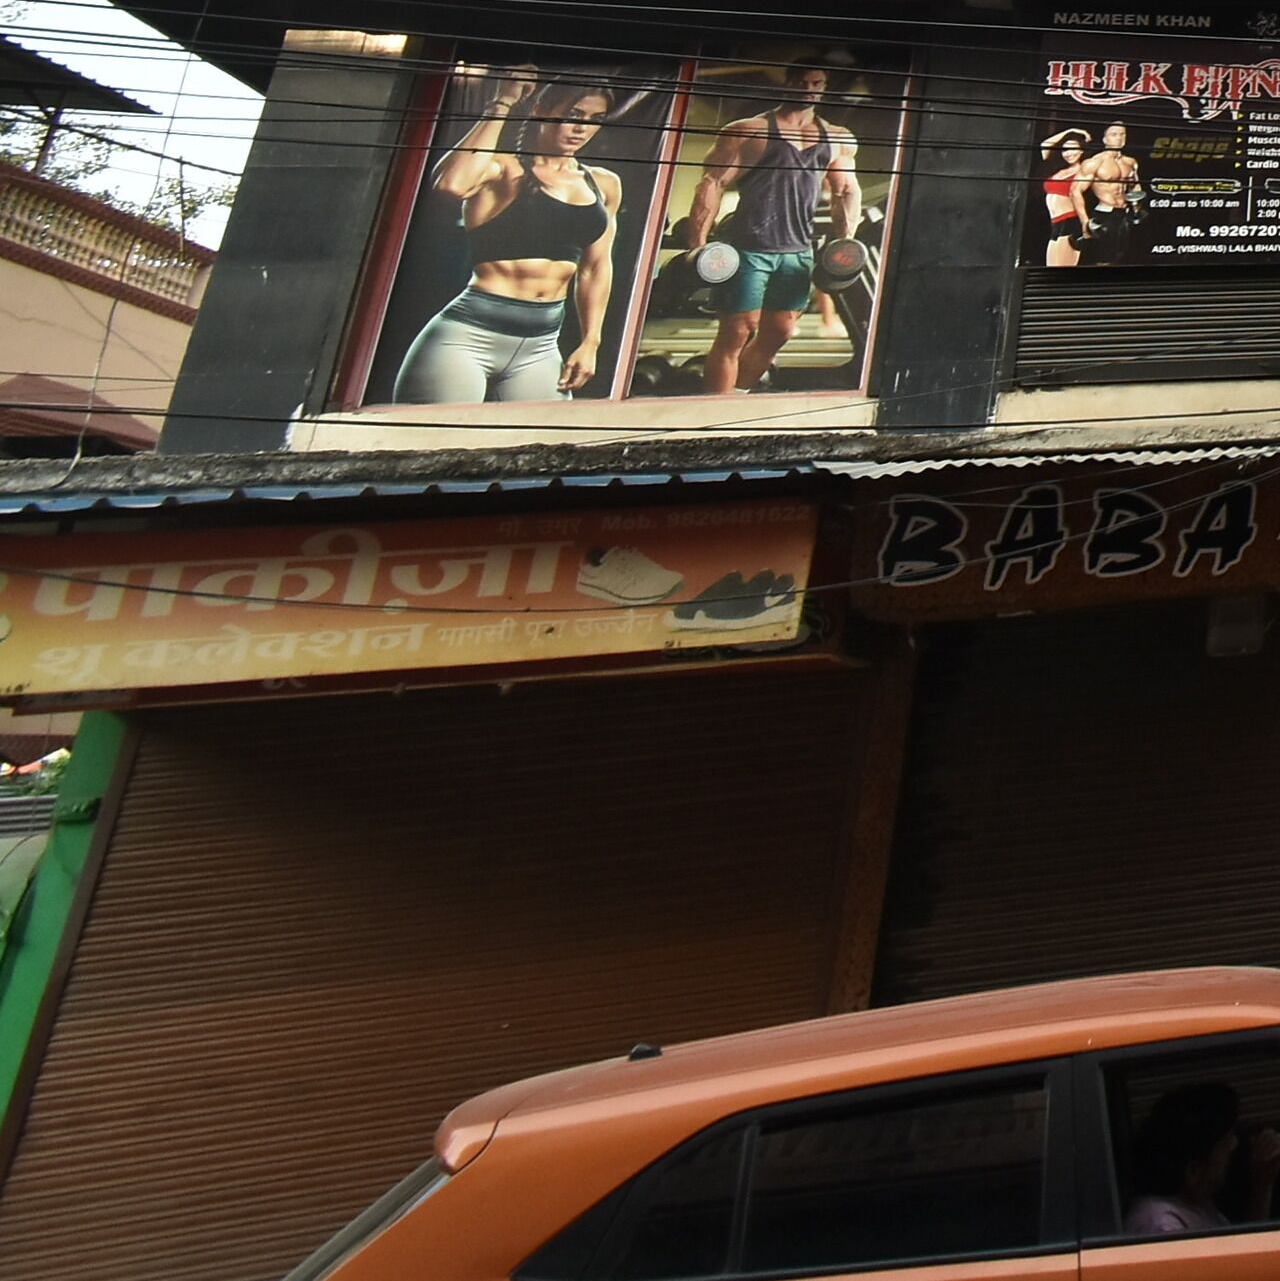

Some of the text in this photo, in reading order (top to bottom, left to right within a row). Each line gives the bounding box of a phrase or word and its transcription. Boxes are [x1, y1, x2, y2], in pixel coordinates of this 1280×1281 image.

[1053, 12, 1212, 28] NAZMEEN KHAN
[1044, 61, 1173, 101] HULK
[1249, 112, 1266, 121] Fat
[1246, 159, 1280, 169] Cardio
[1149, 199, 1240, 208] 6:00 am to 10:00 am
[1255, 198, 1280, 208] 10:00
[1257, 208, 1277, 218] 2:00
[1175, 225, 1205, 237] Mo.
[1177, 244, 1227, 254] (VISHWAS)
[1228, 244, 1253, 253] LALA
[600, 514, 659, 532] Mob.
[878, 481, 1259, 592] BABA
[33, 528, 575, 622] पाकीज़ा
[33, 644, 112, 683] शू
[124, 623, 430, 669] कलेक्शन
[575, 609, 659, 638] उज्जैन
